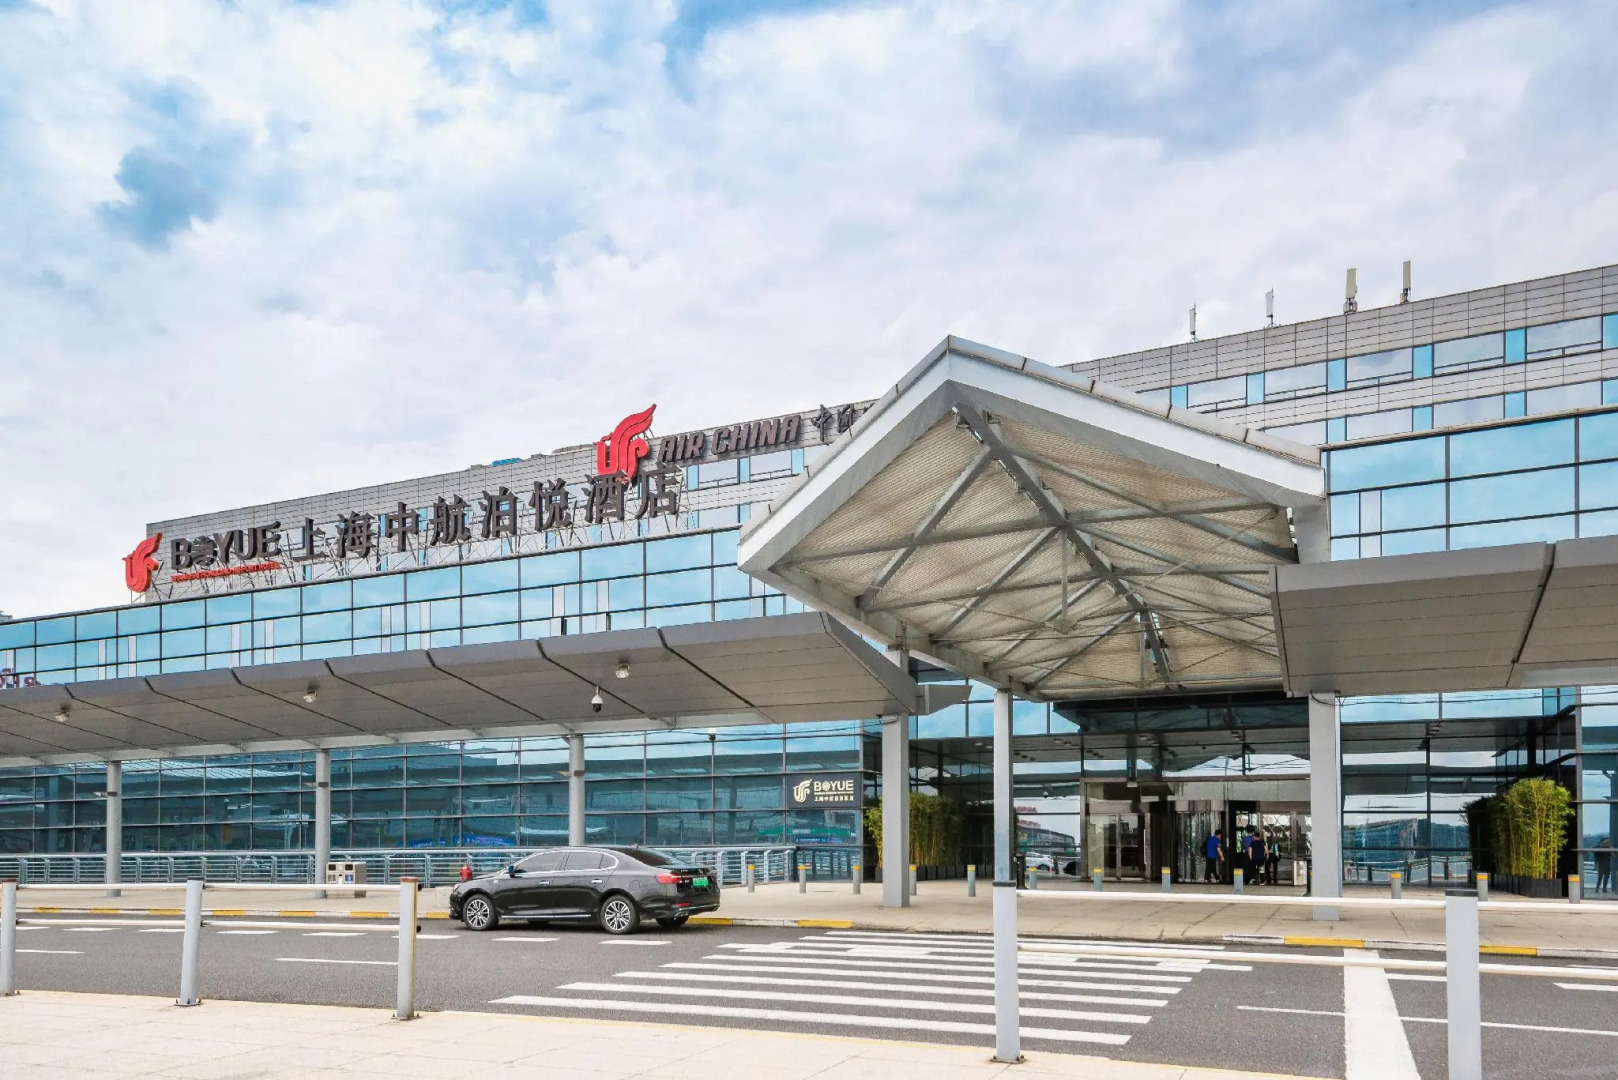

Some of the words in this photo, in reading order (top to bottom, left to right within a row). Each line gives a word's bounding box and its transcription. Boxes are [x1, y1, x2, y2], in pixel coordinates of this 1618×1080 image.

[657, 431, 707, 463] AIR
[710, 414, 802, 456] CHINA
[292, 463, 682, 562] 上海中航泊悦酒店
[171, 521, 281, 570] BOYUE
[814, 780, 854, 791] BOYUE
